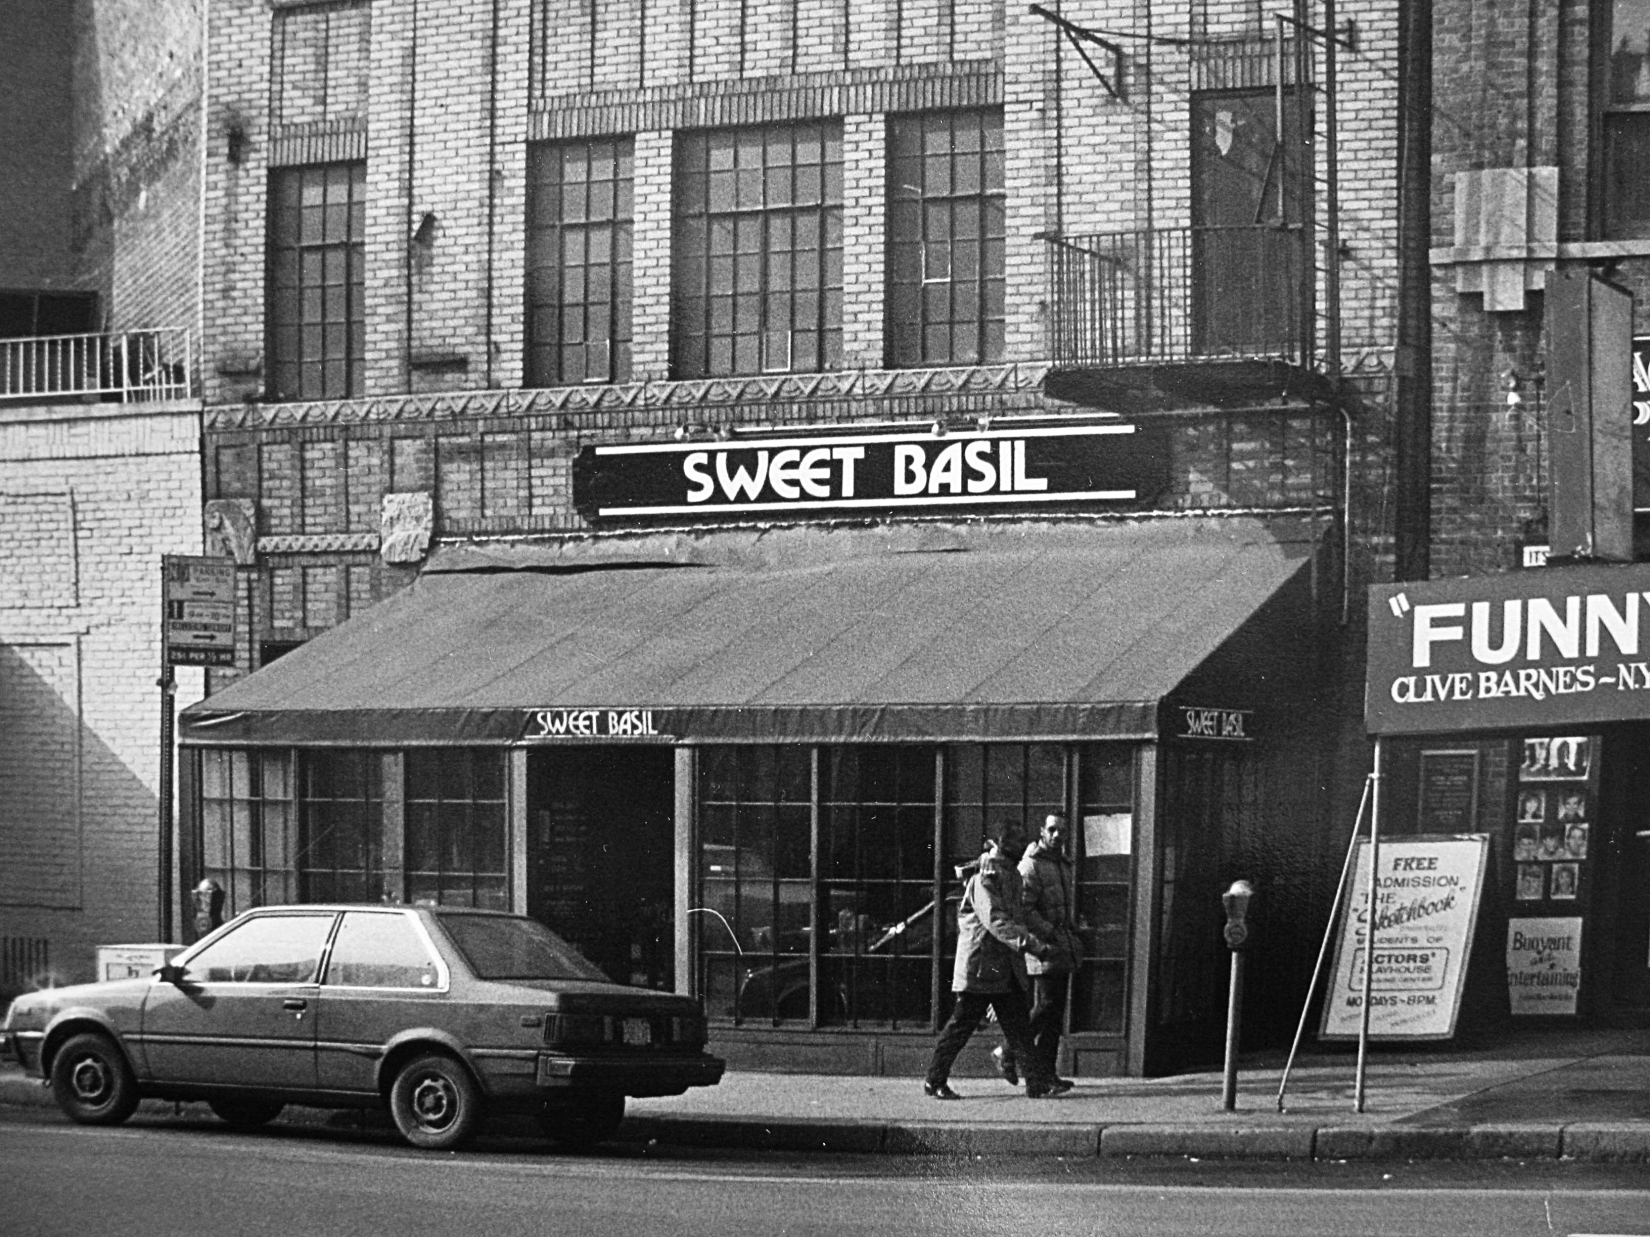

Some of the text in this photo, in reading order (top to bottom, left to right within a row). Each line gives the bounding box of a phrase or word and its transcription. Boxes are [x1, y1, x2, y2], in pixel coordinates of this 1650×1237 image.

[682, 439, 1048, 502] SWEET BASIL
[1388, 592, 1650, 668] "FUNN
[1391, 672, 1473, 703] CLIVE
[536, 710, 658, 735] SWEET BASIL
[1392, 857, 1439, 871] FREE
[1513, 931, 1573, 955] Buoyant
[1508, 967, 1579, 988] ntertaining
